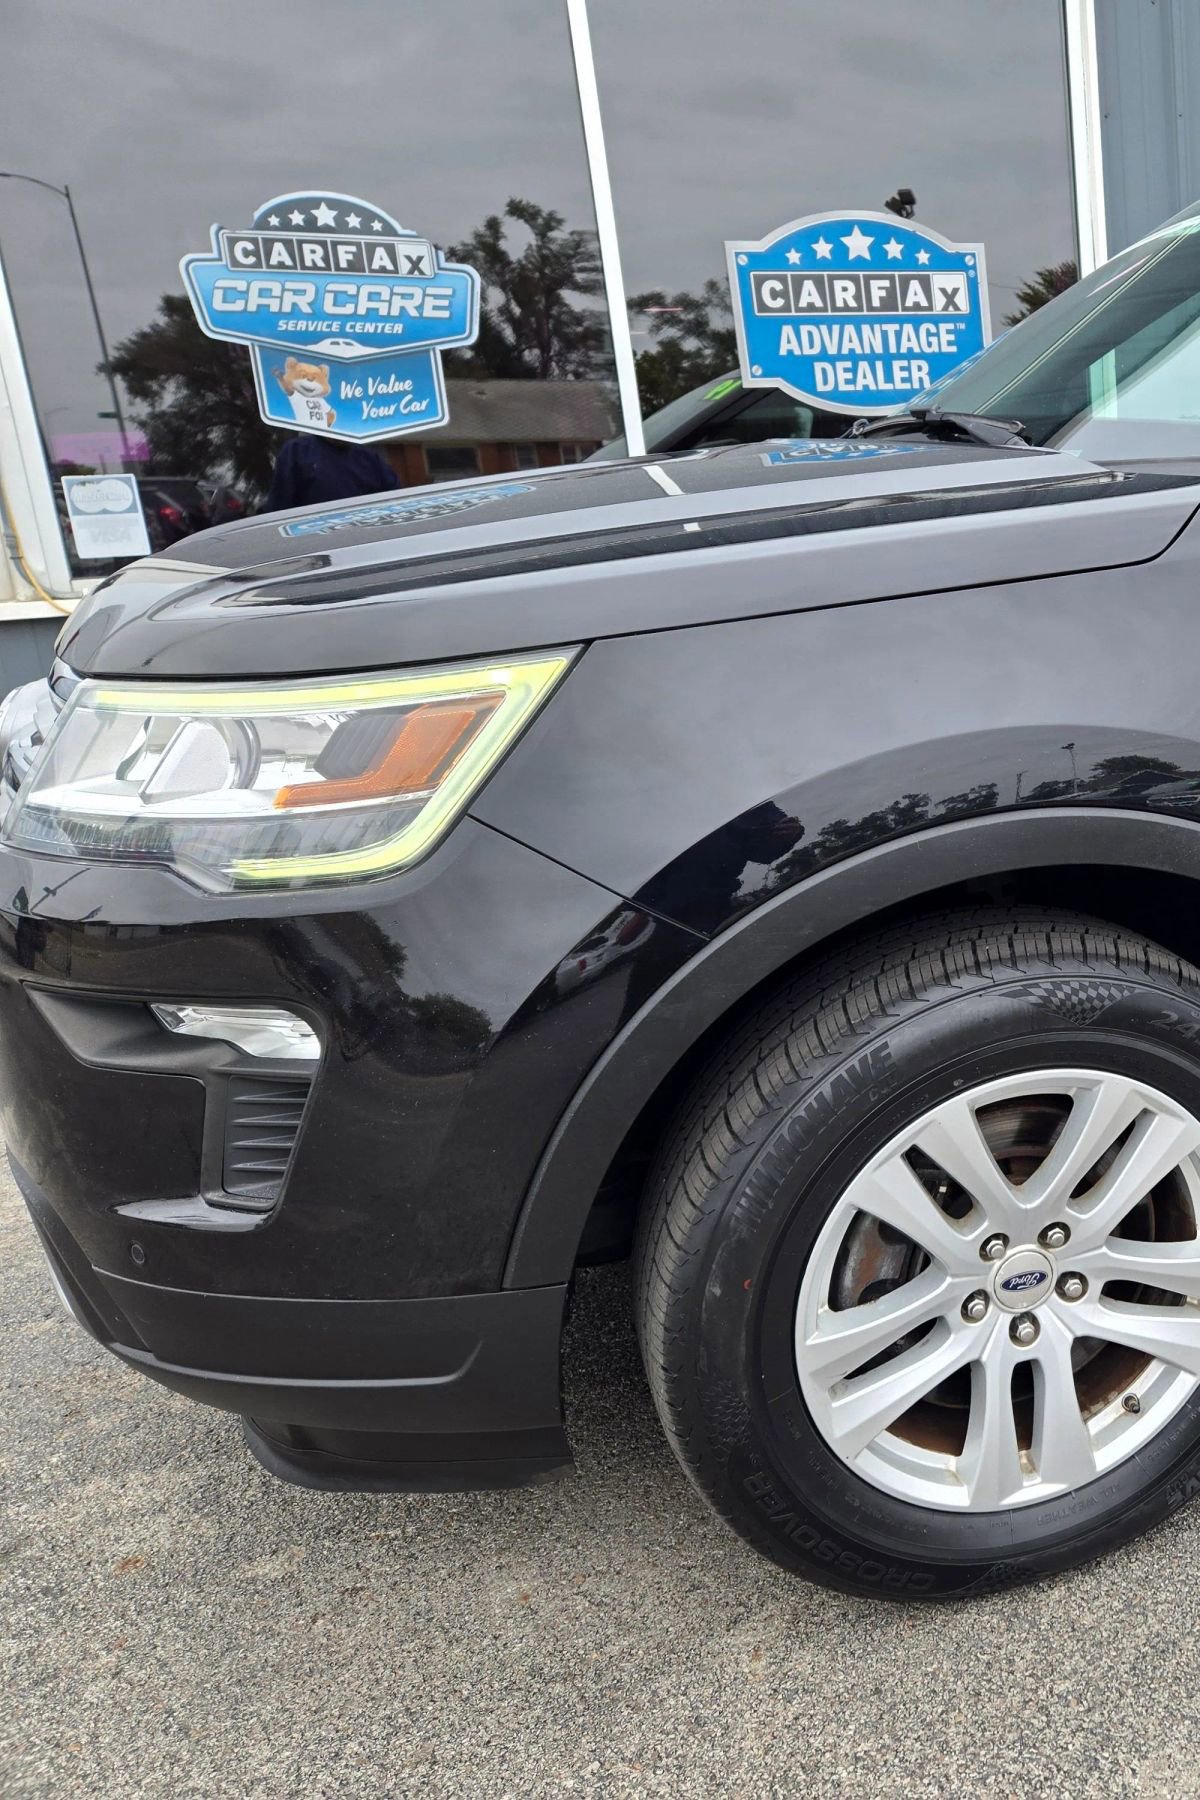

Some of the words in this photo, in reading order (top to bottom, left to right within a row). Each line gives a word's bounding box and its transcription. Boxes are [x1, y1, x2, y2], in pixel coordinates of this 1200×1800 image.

[232, 240, 431, 276] CARFAX
[211, 279, 317, 314] CAR
[322, 282, 454, 318] CARE
[760, 279, 962, 312] CARFAX
[277, 319, 341, 333] SERVICE
[345, 321, 404, 334] CENTER
[340, 379, 364, 400] We
[367, 373, 414, 396] Value
[813, 359, 931, 392] DEALER
[361, 399, 398, 420] Your
[399, 393, 430, 415] Car
[1008, 1272, 1041, 1290] Ford
[741, 1470, 937, 1590] CROSSOVER
